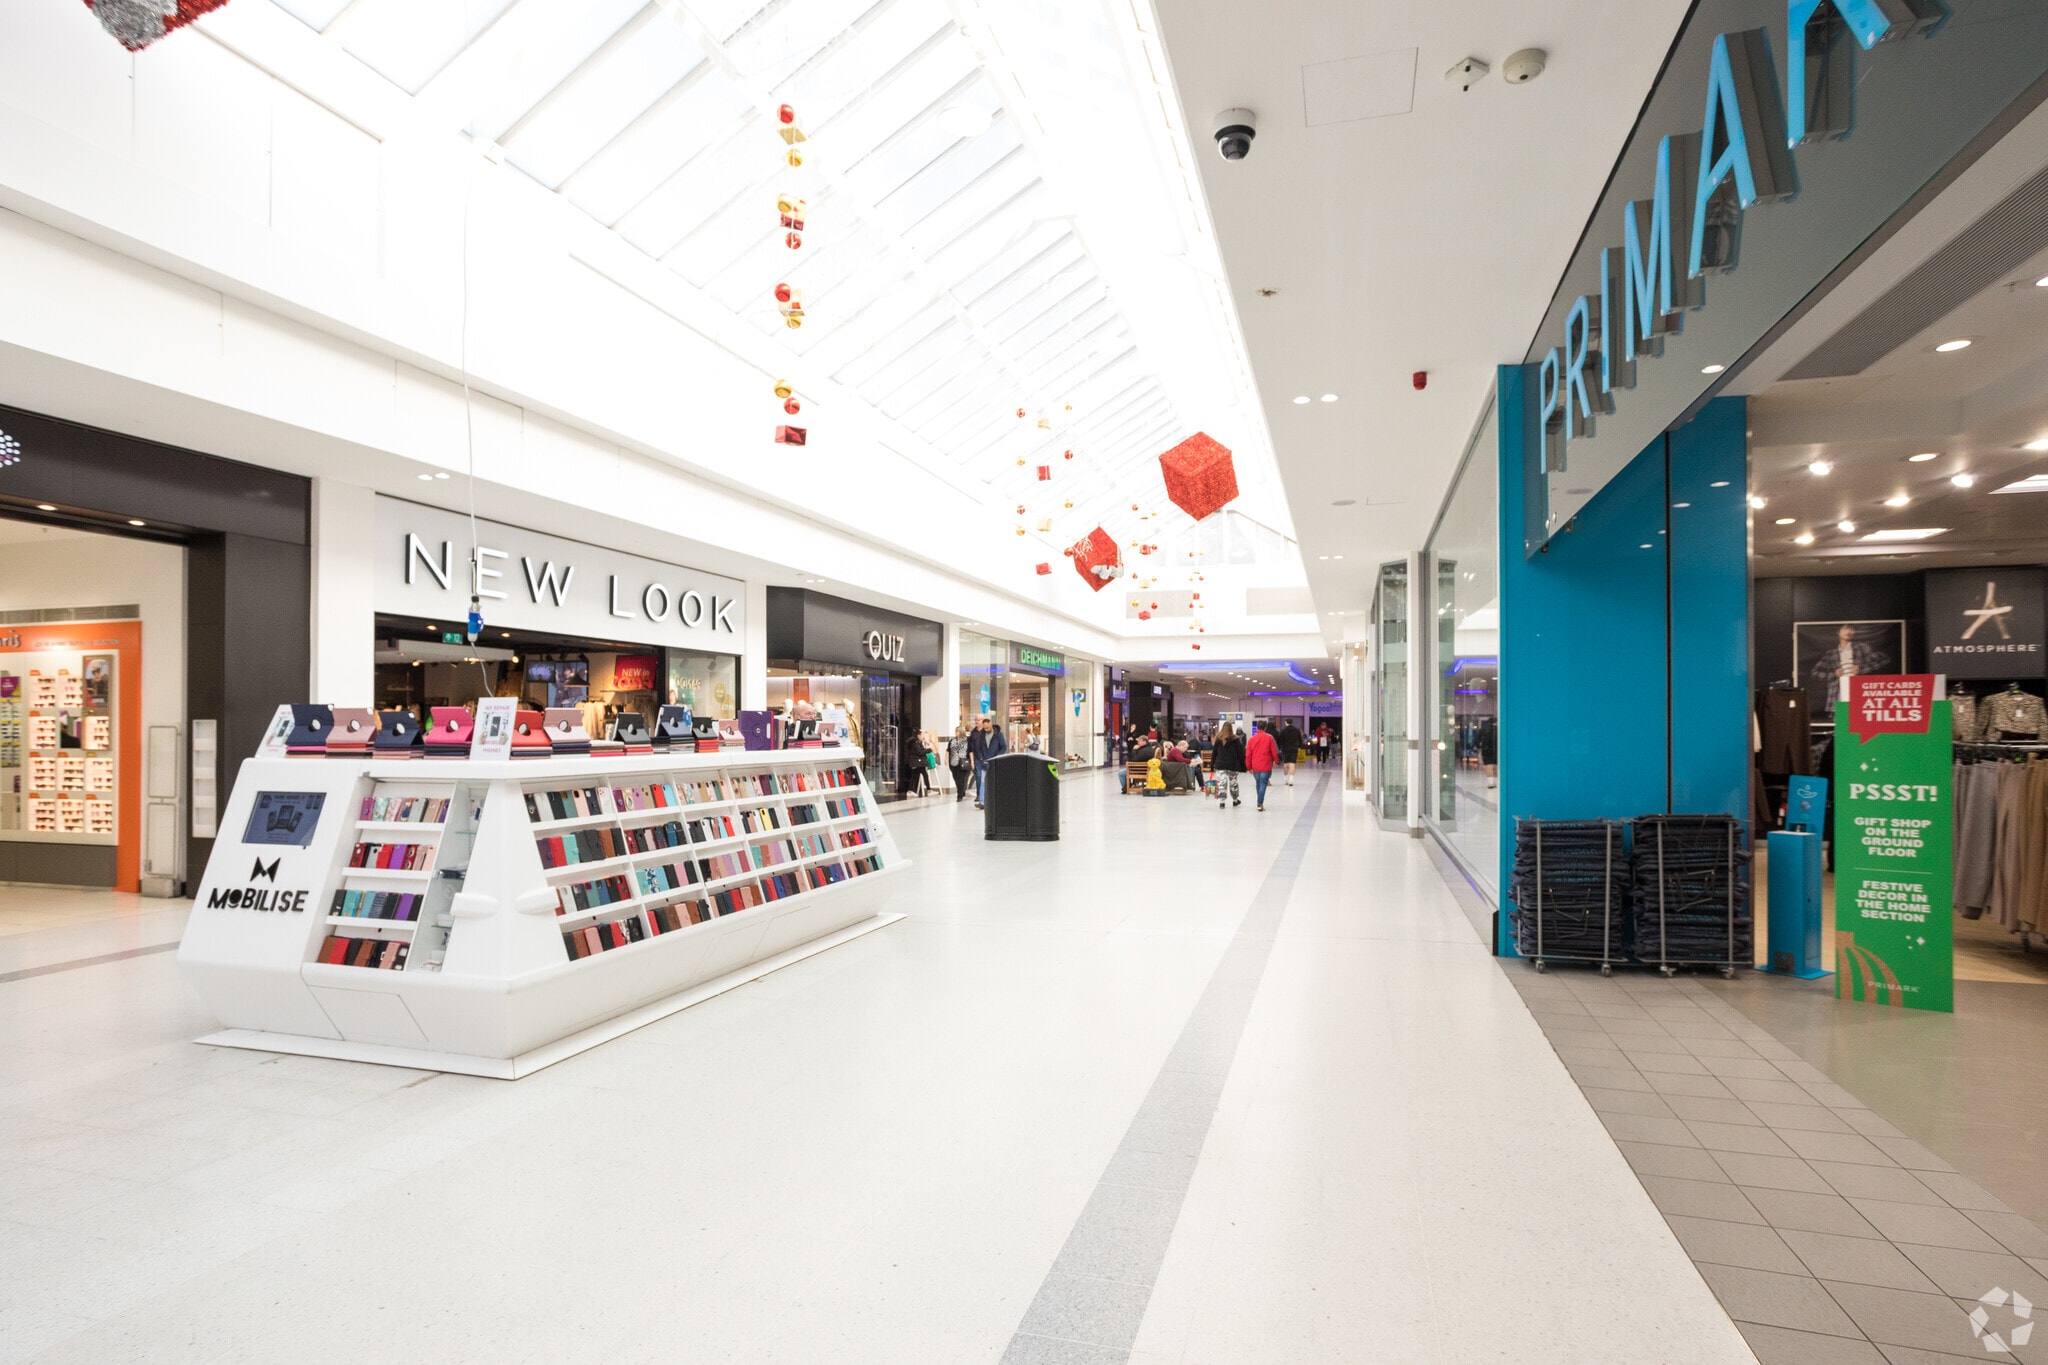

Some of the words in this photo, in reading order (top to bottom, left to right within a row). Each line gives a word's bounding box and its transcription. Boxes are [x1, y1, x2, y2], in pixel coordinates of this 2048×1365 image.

[405, 532, 575, 607] NEW
[610, 574, 736, 633] LOOK
[864, 630, 905, 662] QUIZ
[1933, 644, 2038, 653] ATMOSPHERE
[1021, 647, 1061, 670] DEICHMANN
[622, 668, 642, 676] NEW
[1887, 681, 1922, 689] CARDS
[1862, 689, 1922, 697] AVAILABLE
[1863, 697, 1886, 709] AT
[1889, 697, 1922, 708] ALL
[1862, 709, 1922, 721] TILLS
[1849, 783, 1938, 802] PSSST!
[1854, 817, 1887, 826] GIFT
[1890, 818, 1932, 828] SHOP
[1865, 827, 1887, 836] ON
[1890, 828, 1920, 838] THE
[1861, 837, 1924, 848] GROUND
[1868, 847, 1917, 858] FLOOR
[1862, 880, 1923, 892] FESTIVE
[207, 887, 309, 912] MOBILISE
[1858, 890, 1908, 901] DECOR
[1911, 894, 1928, 903] IN
[1855, 899, 1884, 909] THE
[1887, 902, 1931, 913] HOME
[1861, 909, 1925, 923] SECTION
[1867, 980, 1920, 993] PRIMARK
